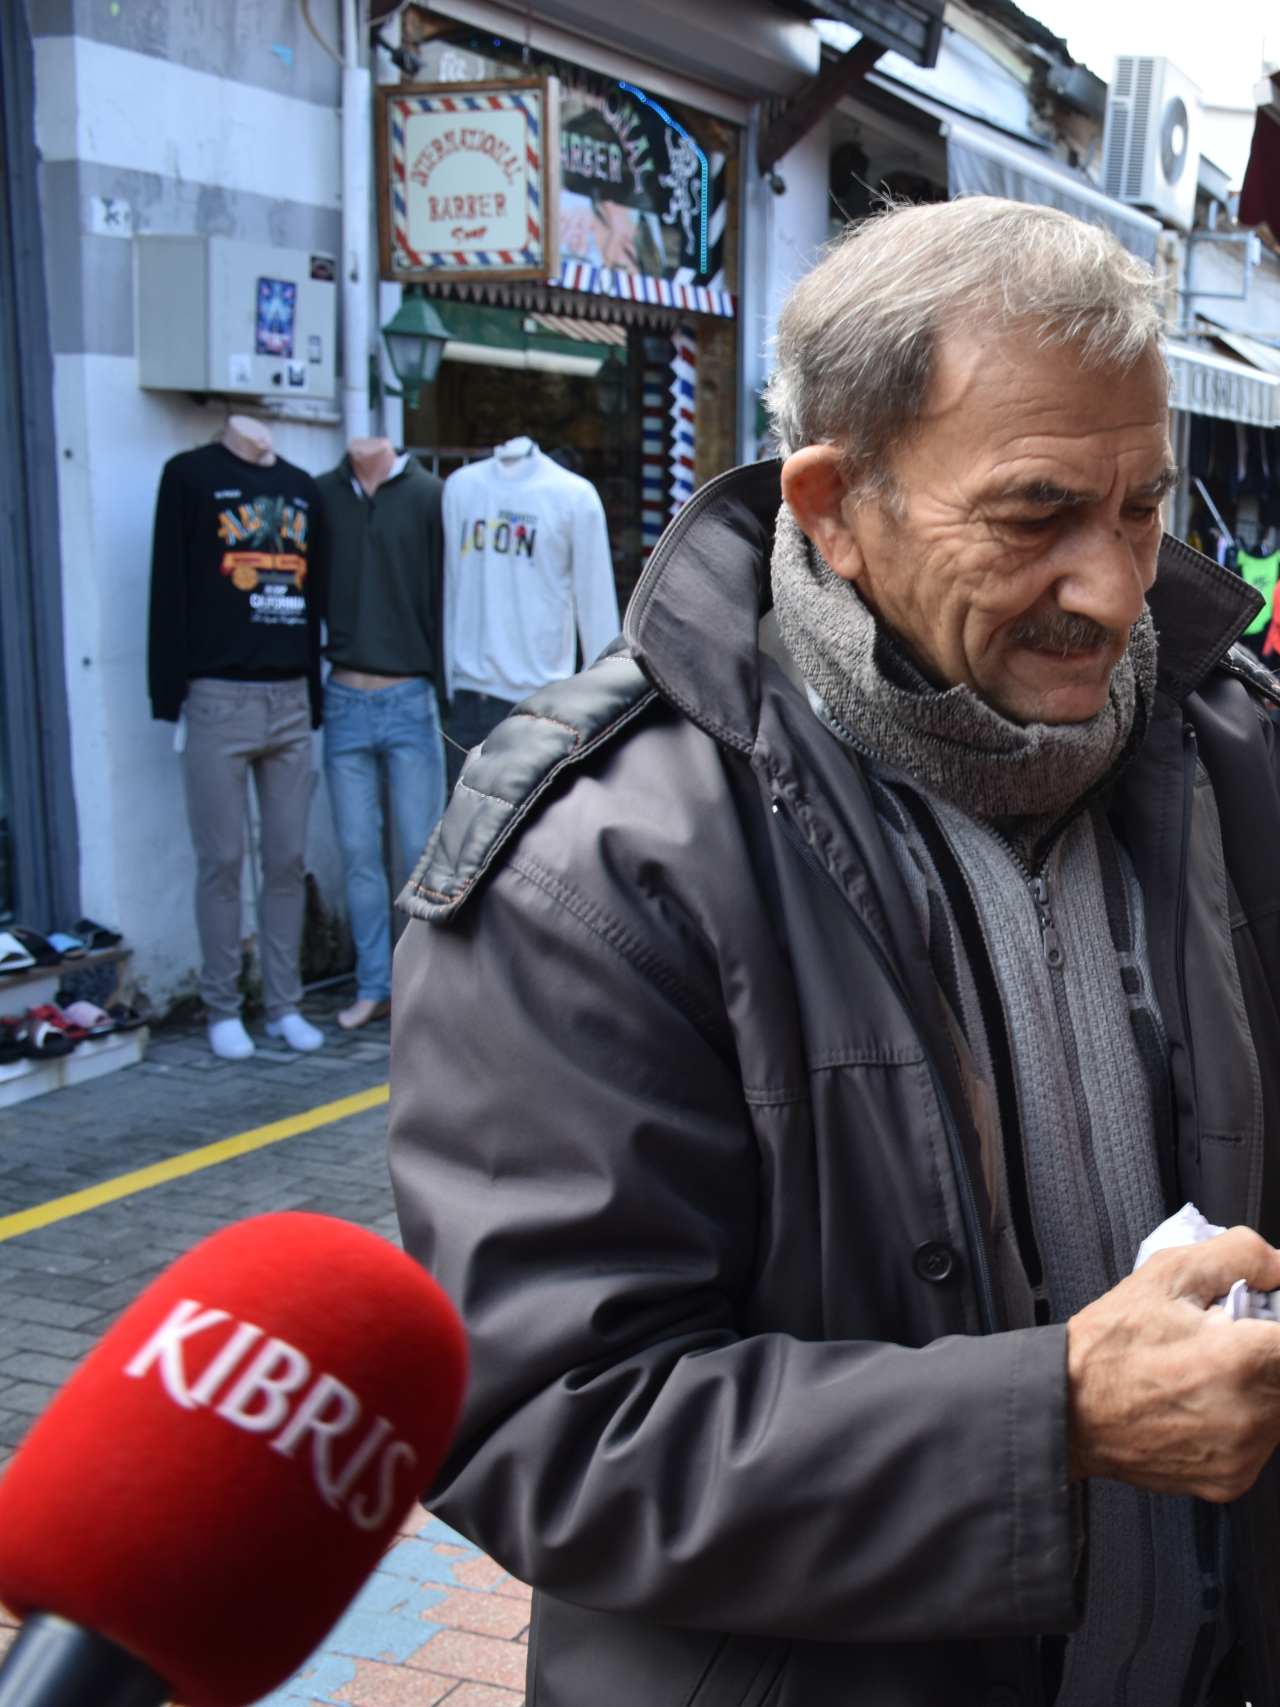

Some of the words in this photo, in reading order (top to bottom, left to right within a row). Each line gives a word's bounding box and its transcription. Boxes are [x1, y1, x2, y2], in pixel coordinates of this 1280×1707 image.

[411, 128, 523, 189] INTERNATIONAL
[428, 192, 508, 223] BARBER
[123, 1298, 418, 1532] KIBRIS
